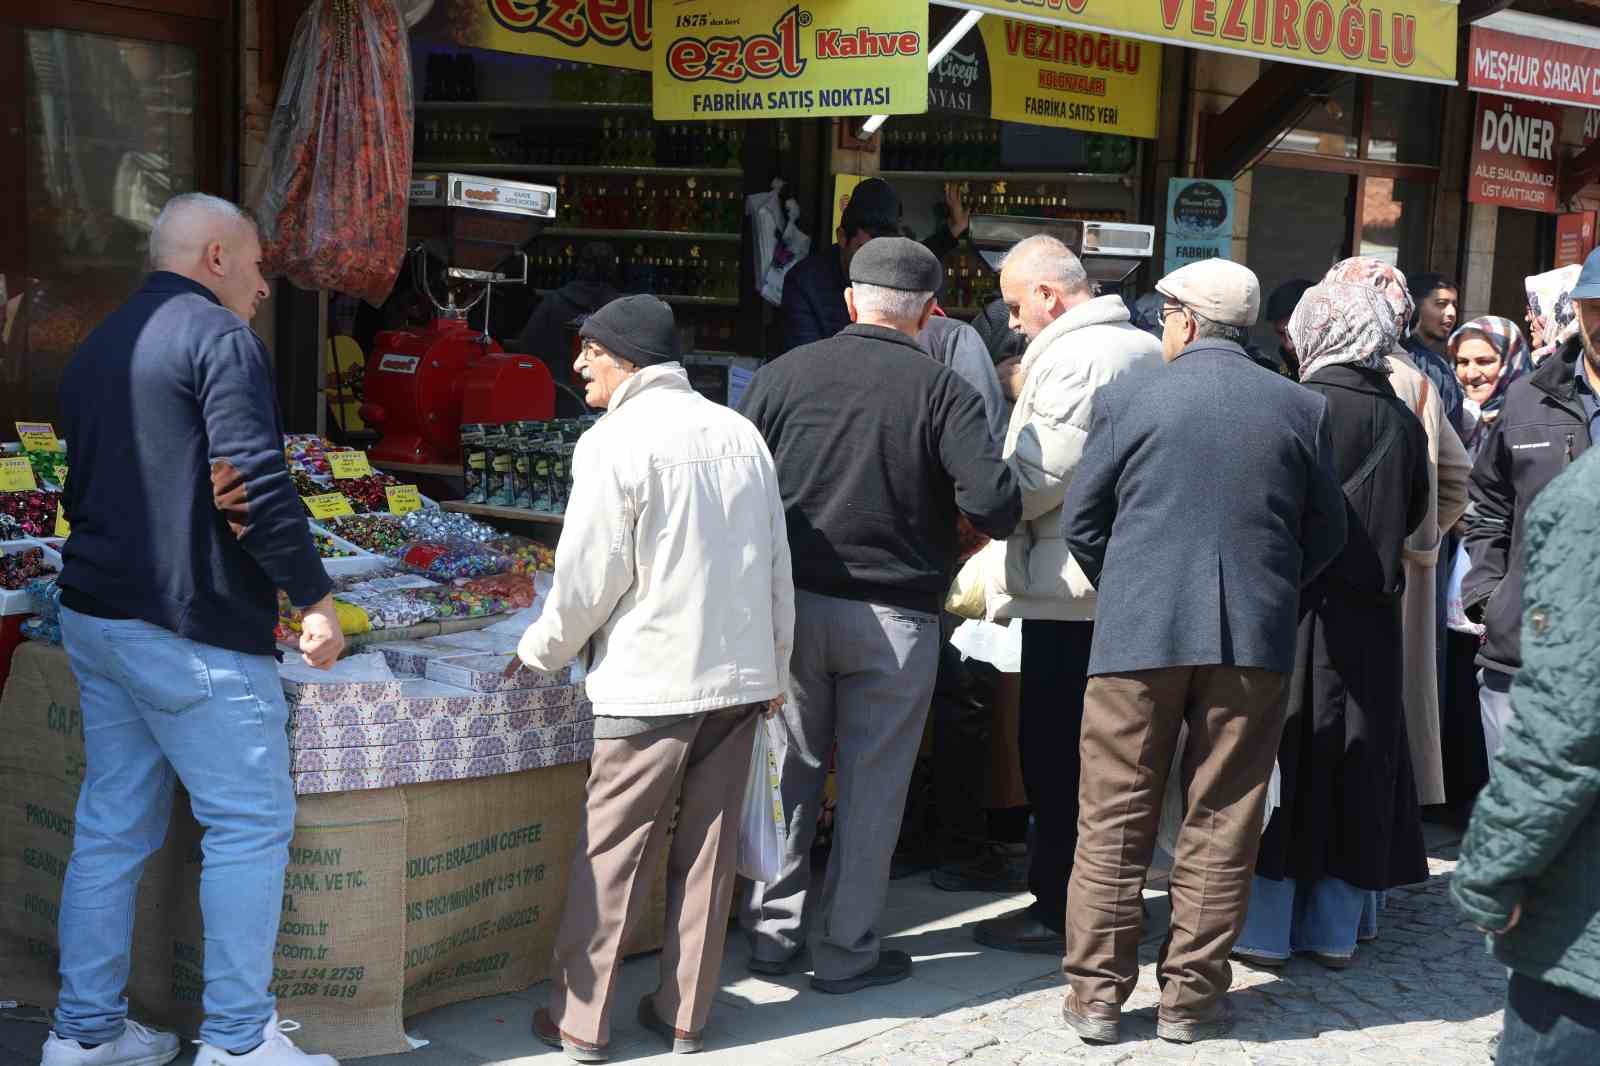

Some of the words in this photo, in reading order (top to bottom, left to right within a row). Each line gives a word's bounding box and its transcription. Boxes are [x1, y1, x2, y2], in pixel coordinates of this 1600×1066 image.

[667, 5, 807, 84] ezel
[815, 27, 920, 60] Kahve
[1475, 48, 1540, 90] MEŞHUR
[1543, 60, 1590, 94] SARAY
[692, 90, 764, 112] FABRİKA
[767, 91, 814, 113] SATIŞ
[818, 87, 890, 110] NOKTASI
[1025, 96, 1066, 119] FABRİKA
[1097, 105, 1118, 126] YERİ
[1480, 103, 1555, 161] DÖNER
[500, 824, 543, 851] COFFEE
